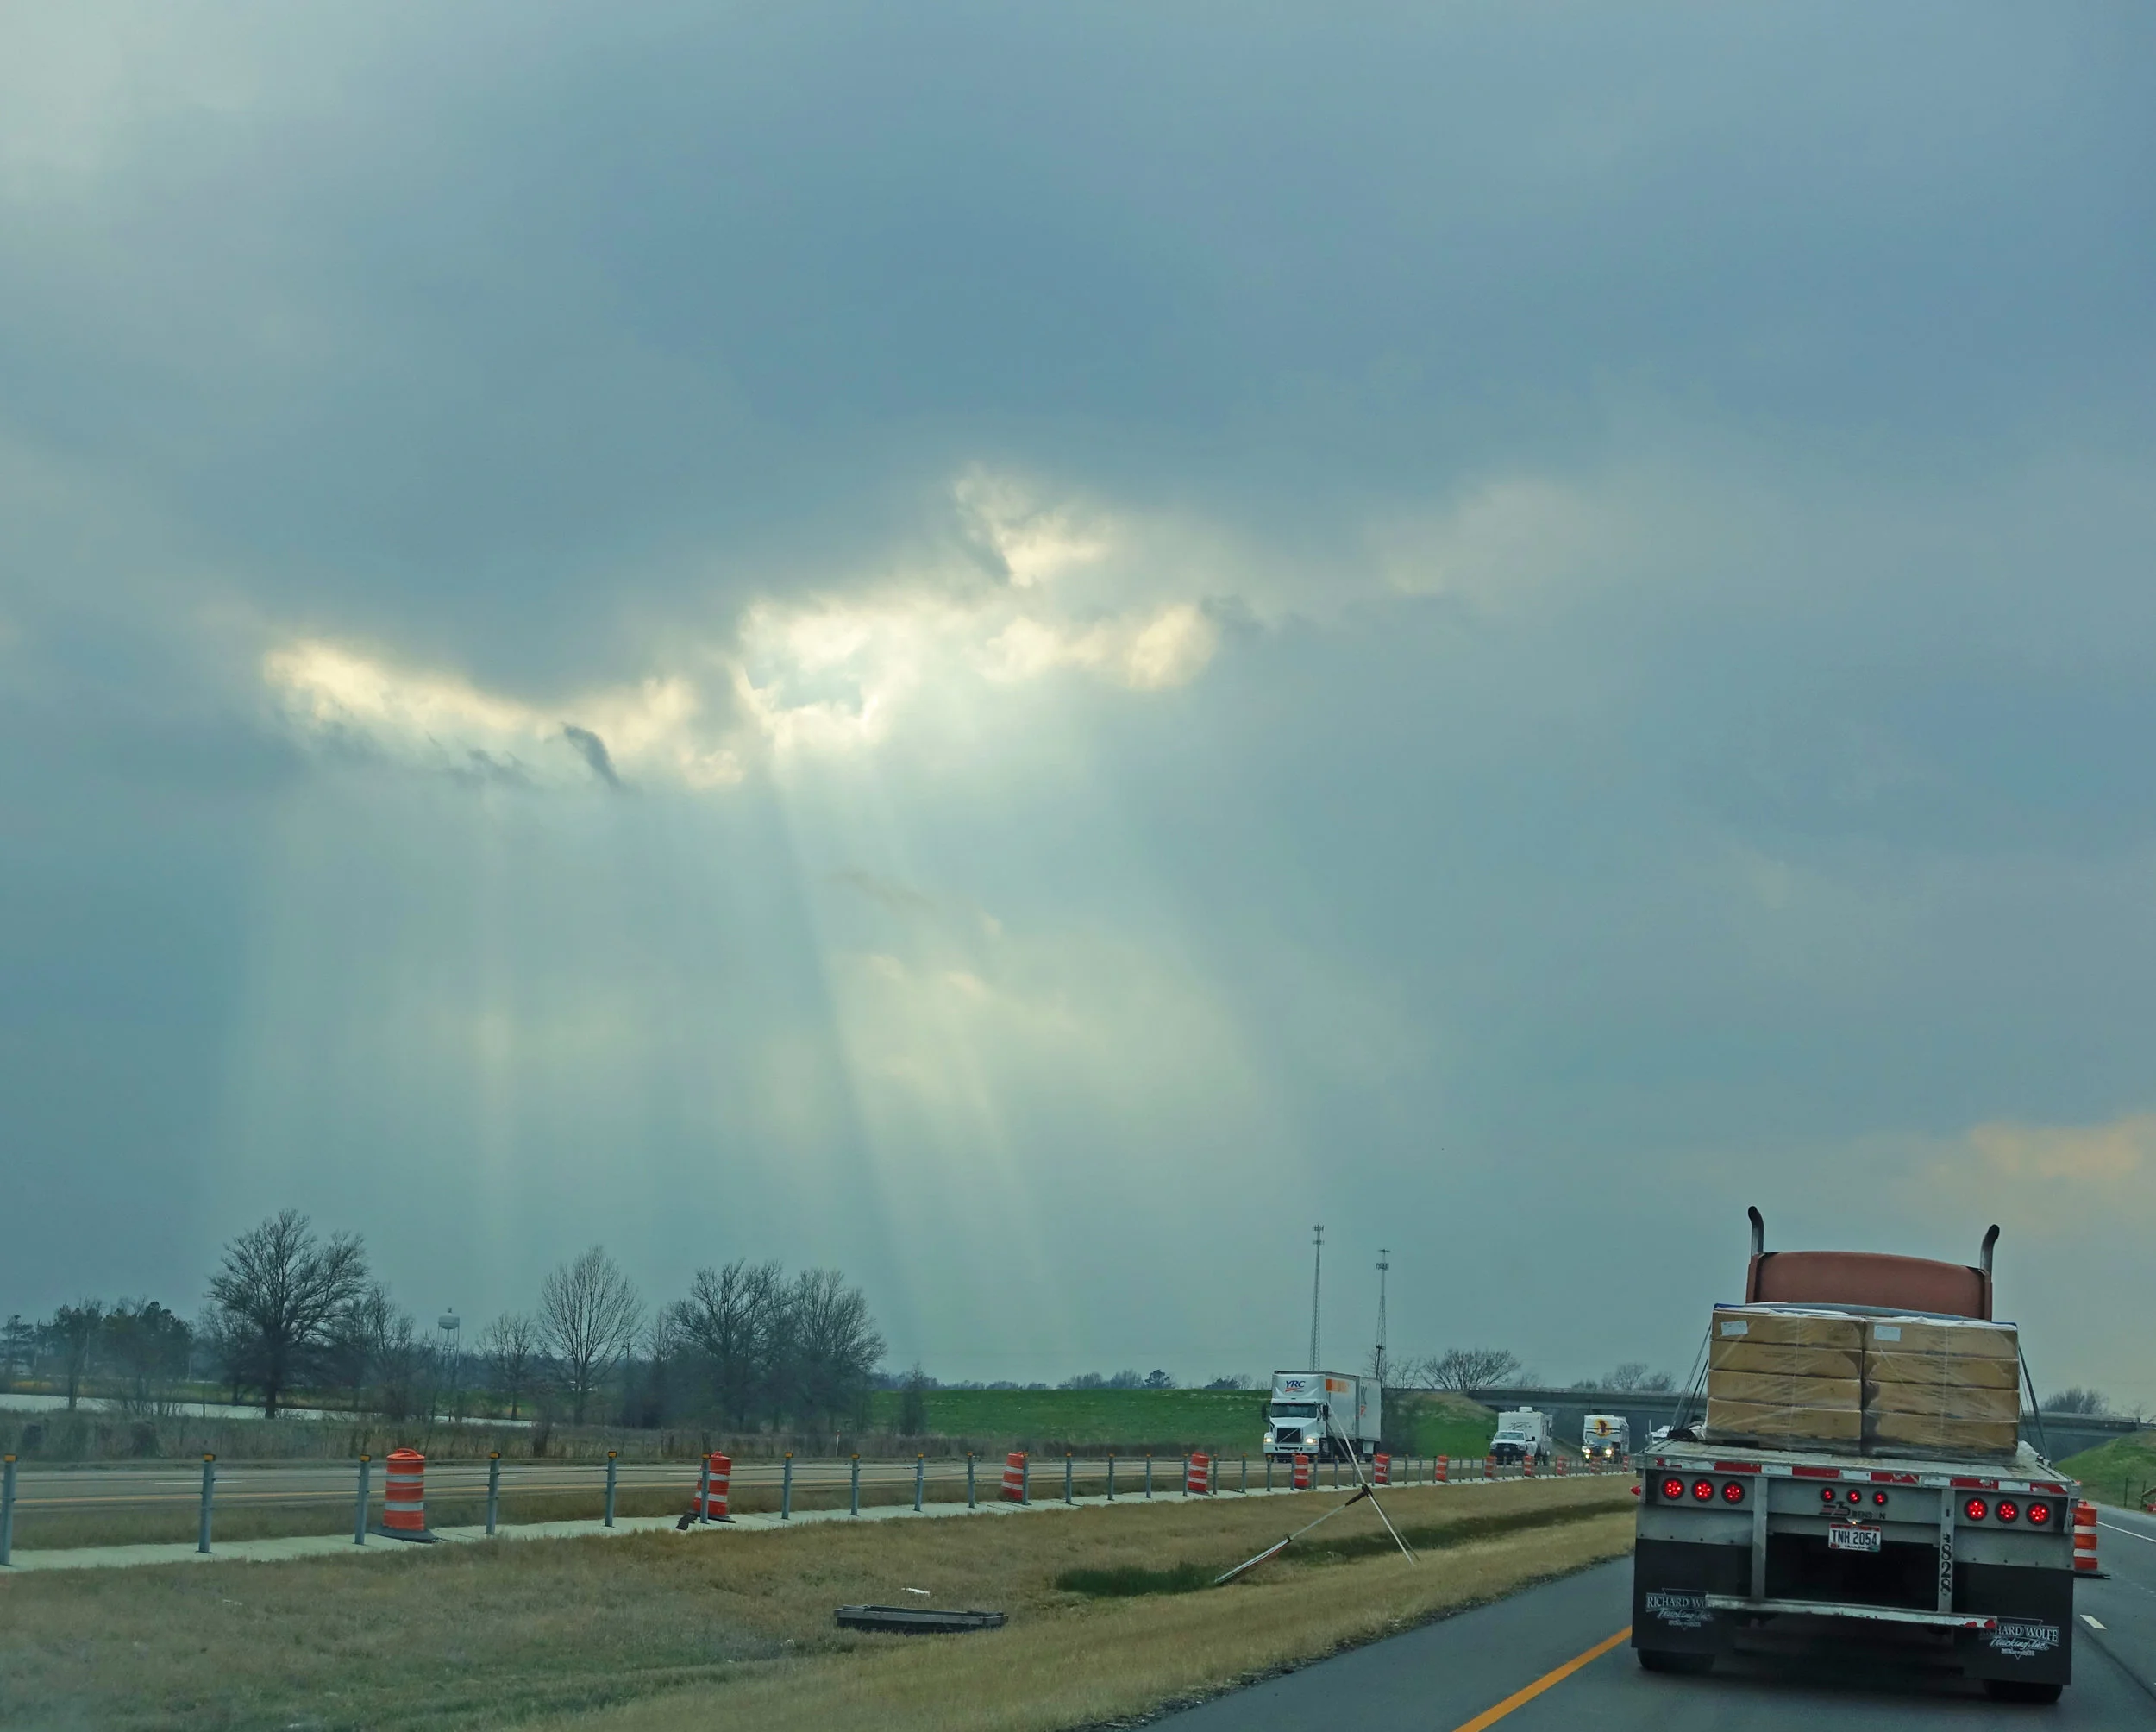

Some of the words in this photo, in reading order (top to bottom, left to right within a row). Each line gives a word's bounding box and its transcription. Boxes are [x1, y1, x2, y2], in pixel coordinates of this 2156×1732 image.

[1832, 1530, 1850, 1544] TNH
[1853, 1532, 1877, 1546] 2054
[1647, 1596, 1689, 1608] RICHARD
[2026, 1626, 2058, 1642] WOLFE
[1990, 1636, 2028, 1651] Trucking
